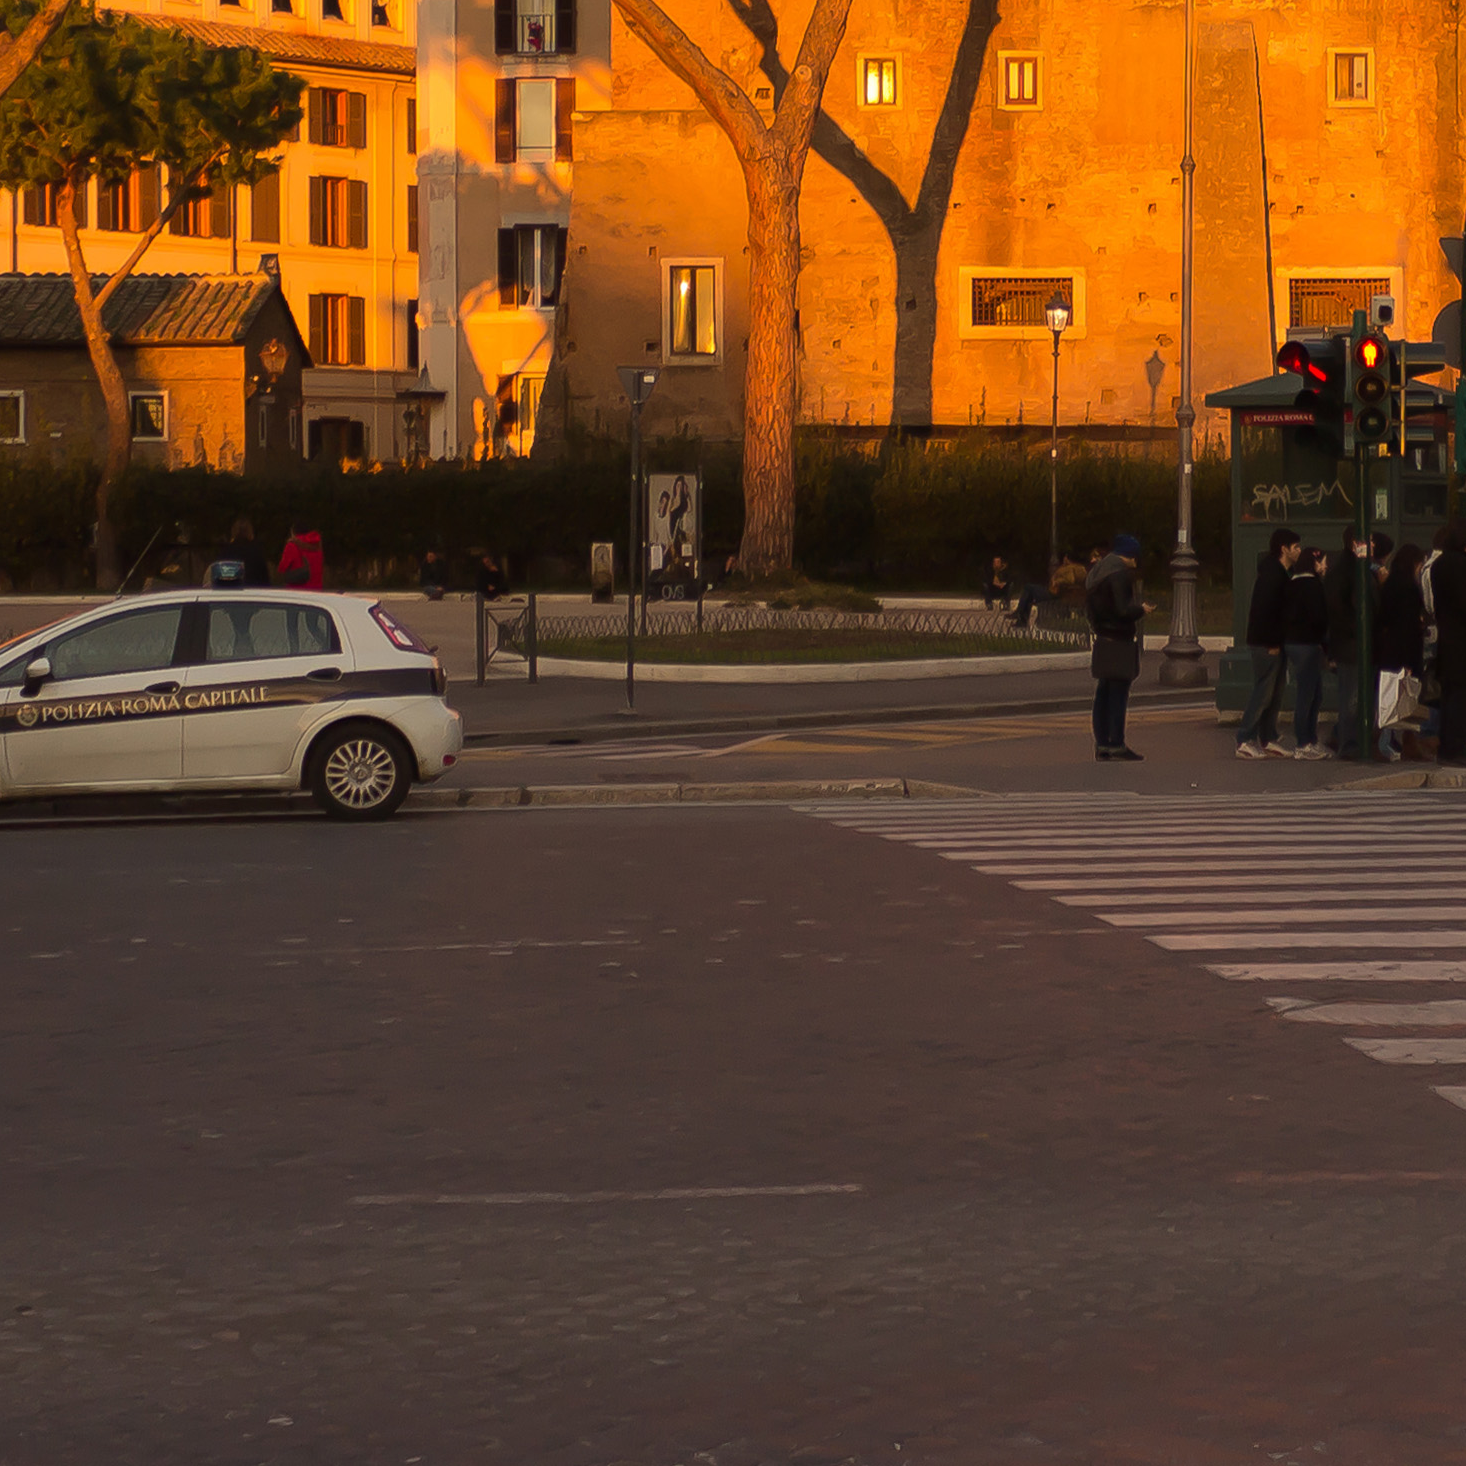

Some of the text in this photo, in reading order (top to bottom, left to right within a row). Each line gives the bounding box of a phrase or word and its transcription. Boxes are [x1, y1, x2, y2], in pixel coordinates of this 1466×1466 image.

[41, 686, 269, 722] POLIZIA ROMA CAPITALE
